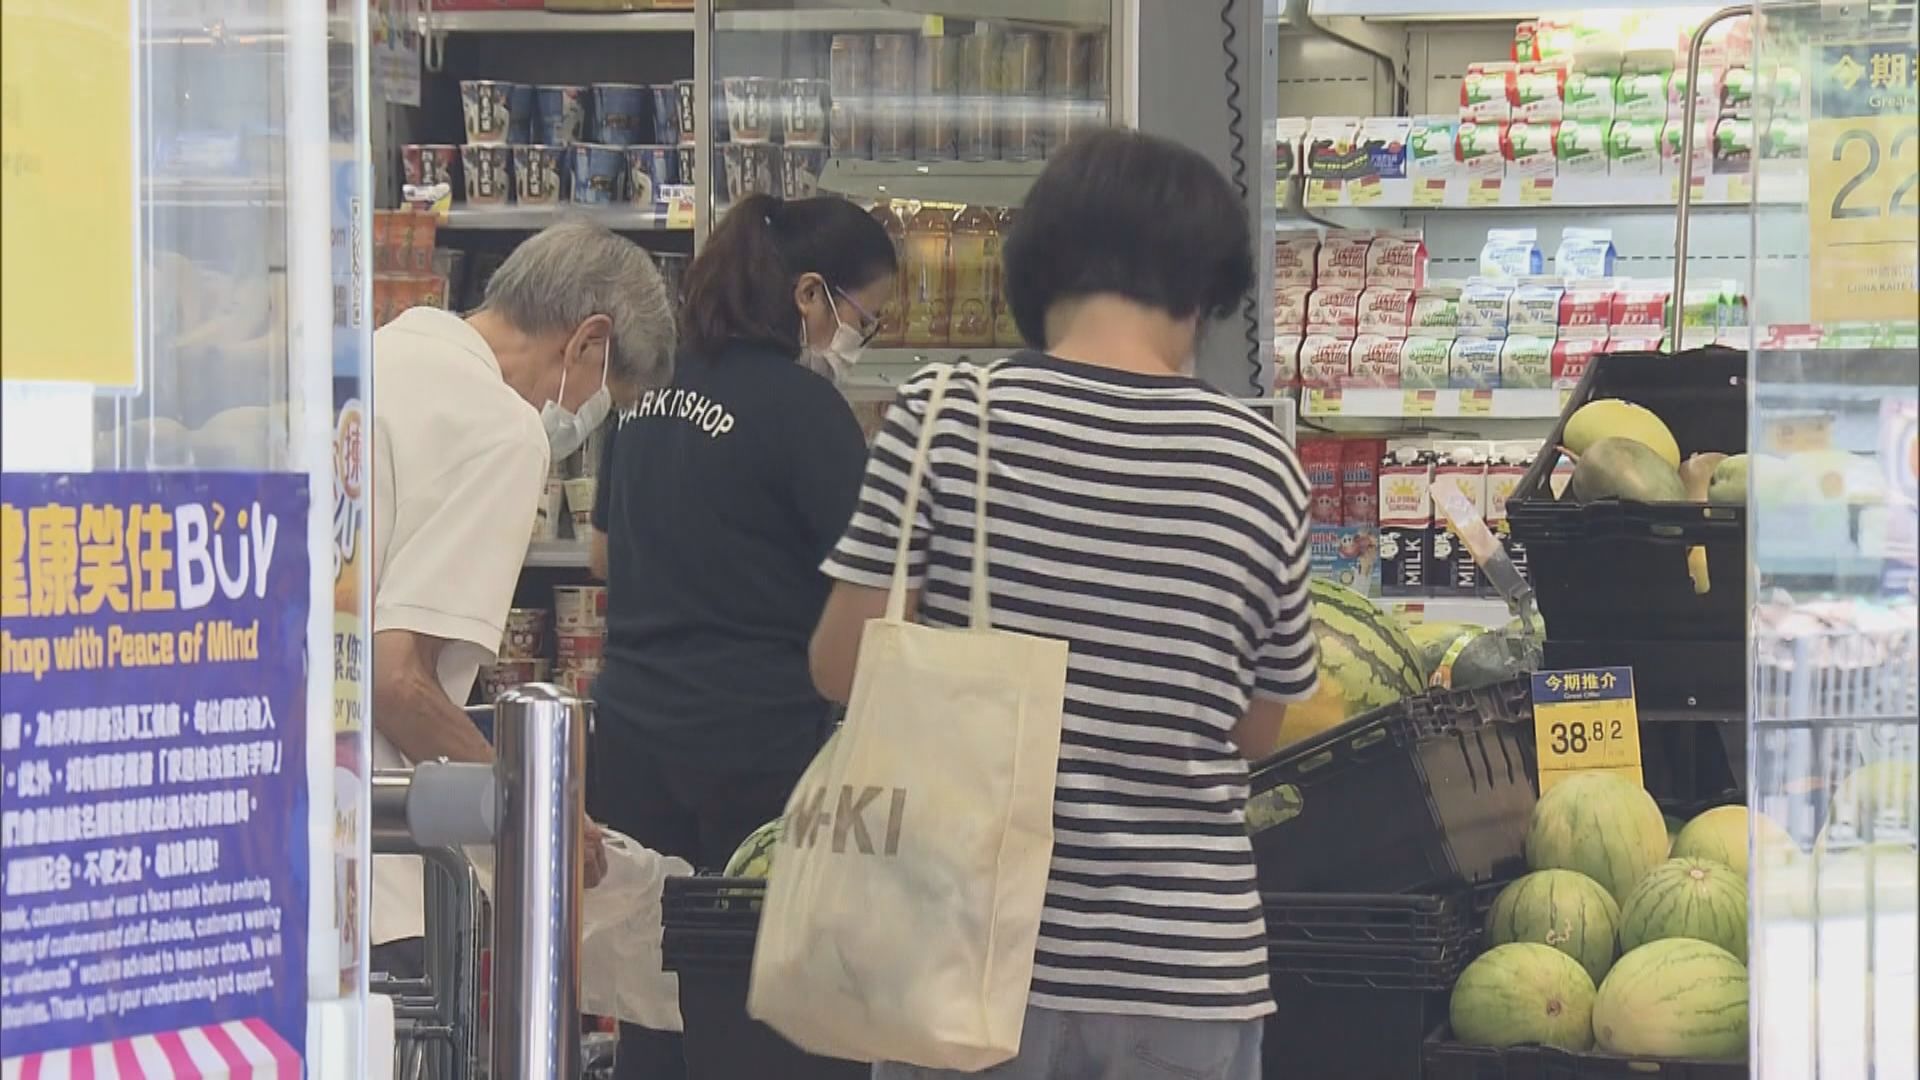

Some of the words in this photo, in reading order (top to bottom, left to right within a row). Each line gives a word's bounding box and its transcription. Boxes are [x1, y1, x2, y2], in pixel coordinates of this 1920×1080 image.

[1832, 53, 1918, 90] 今期
[1405, 538, 1421, 586] MILK
[54, 626, 103, 671] with
[107, 625, 174, 668] Peace
[178, 622, 204, 664] of
[207, 619, 261, 662] Mind
[1545, 672, 1617, 692] 今期推介
